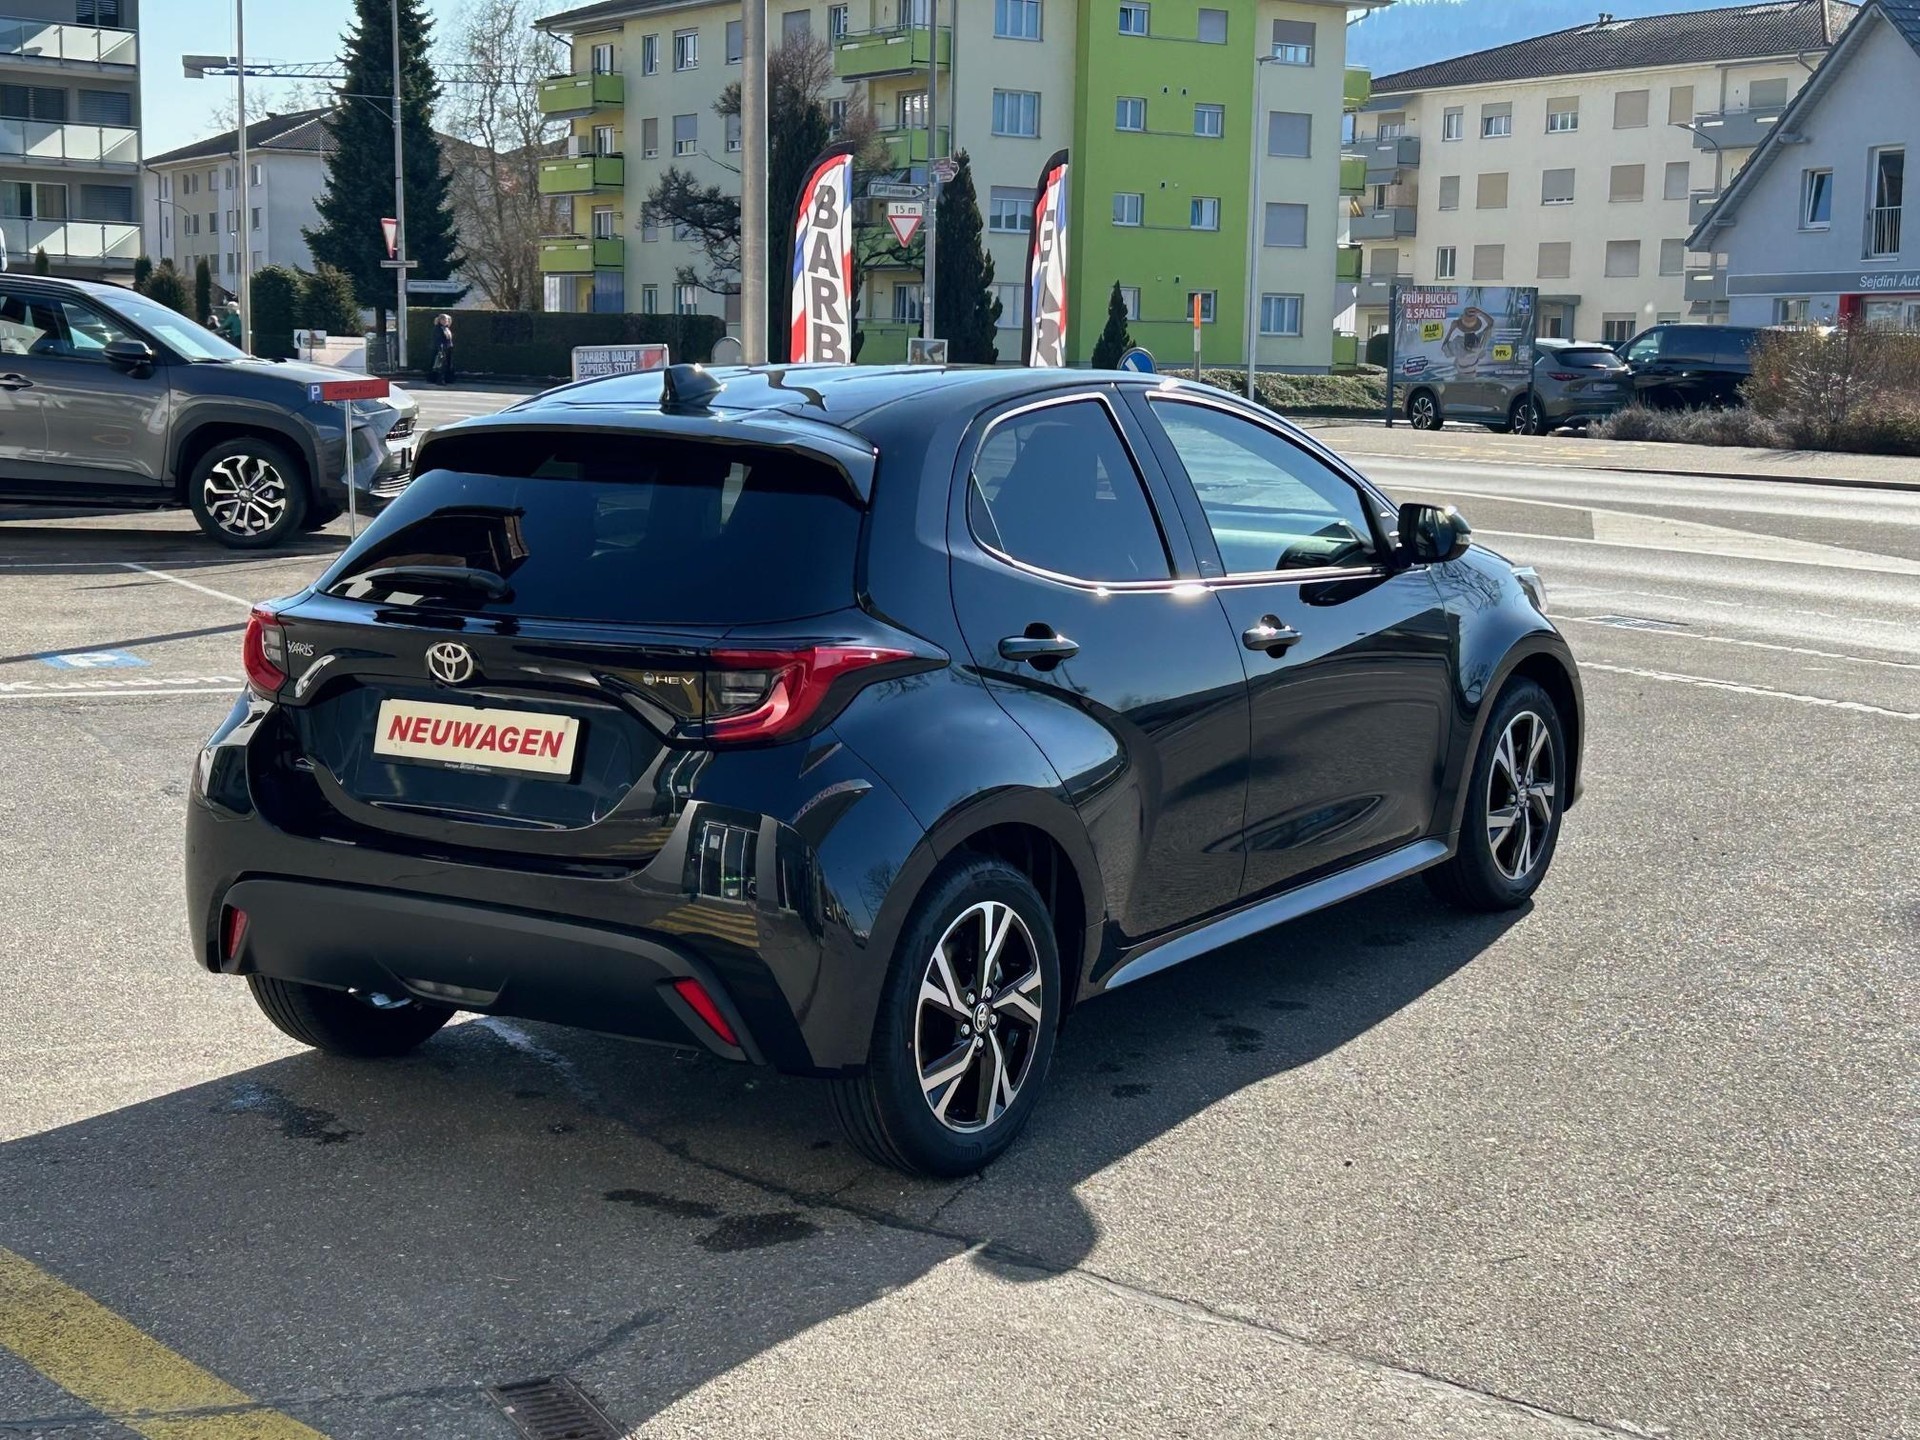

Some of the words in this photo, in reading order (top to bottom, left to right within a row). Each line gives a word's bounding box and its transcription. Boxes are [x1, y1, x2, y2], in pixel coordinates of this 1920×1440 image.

[895, 205, 905, 214] 15
[1860, 275, 1898, 289] Sejdini
[1899, 273, 1920, 287] Aut
[1401, 290, 1423, 304] FRÜH
[1425, 293, 1458, 304] BUCHEN
[1406, 308, 1413, 319] &
[1414, 308, 1446, 319] SPAREN
[580, 363, 611, 375] EXPRESS
[614, 362, 636, 373] STYLE
[311, 385, 320, 400] P
[286, 640, 315, 657] YARIS
[655, 676, 695, 685] HEV
[387, 715, 564, 758] NEUWAGEN
